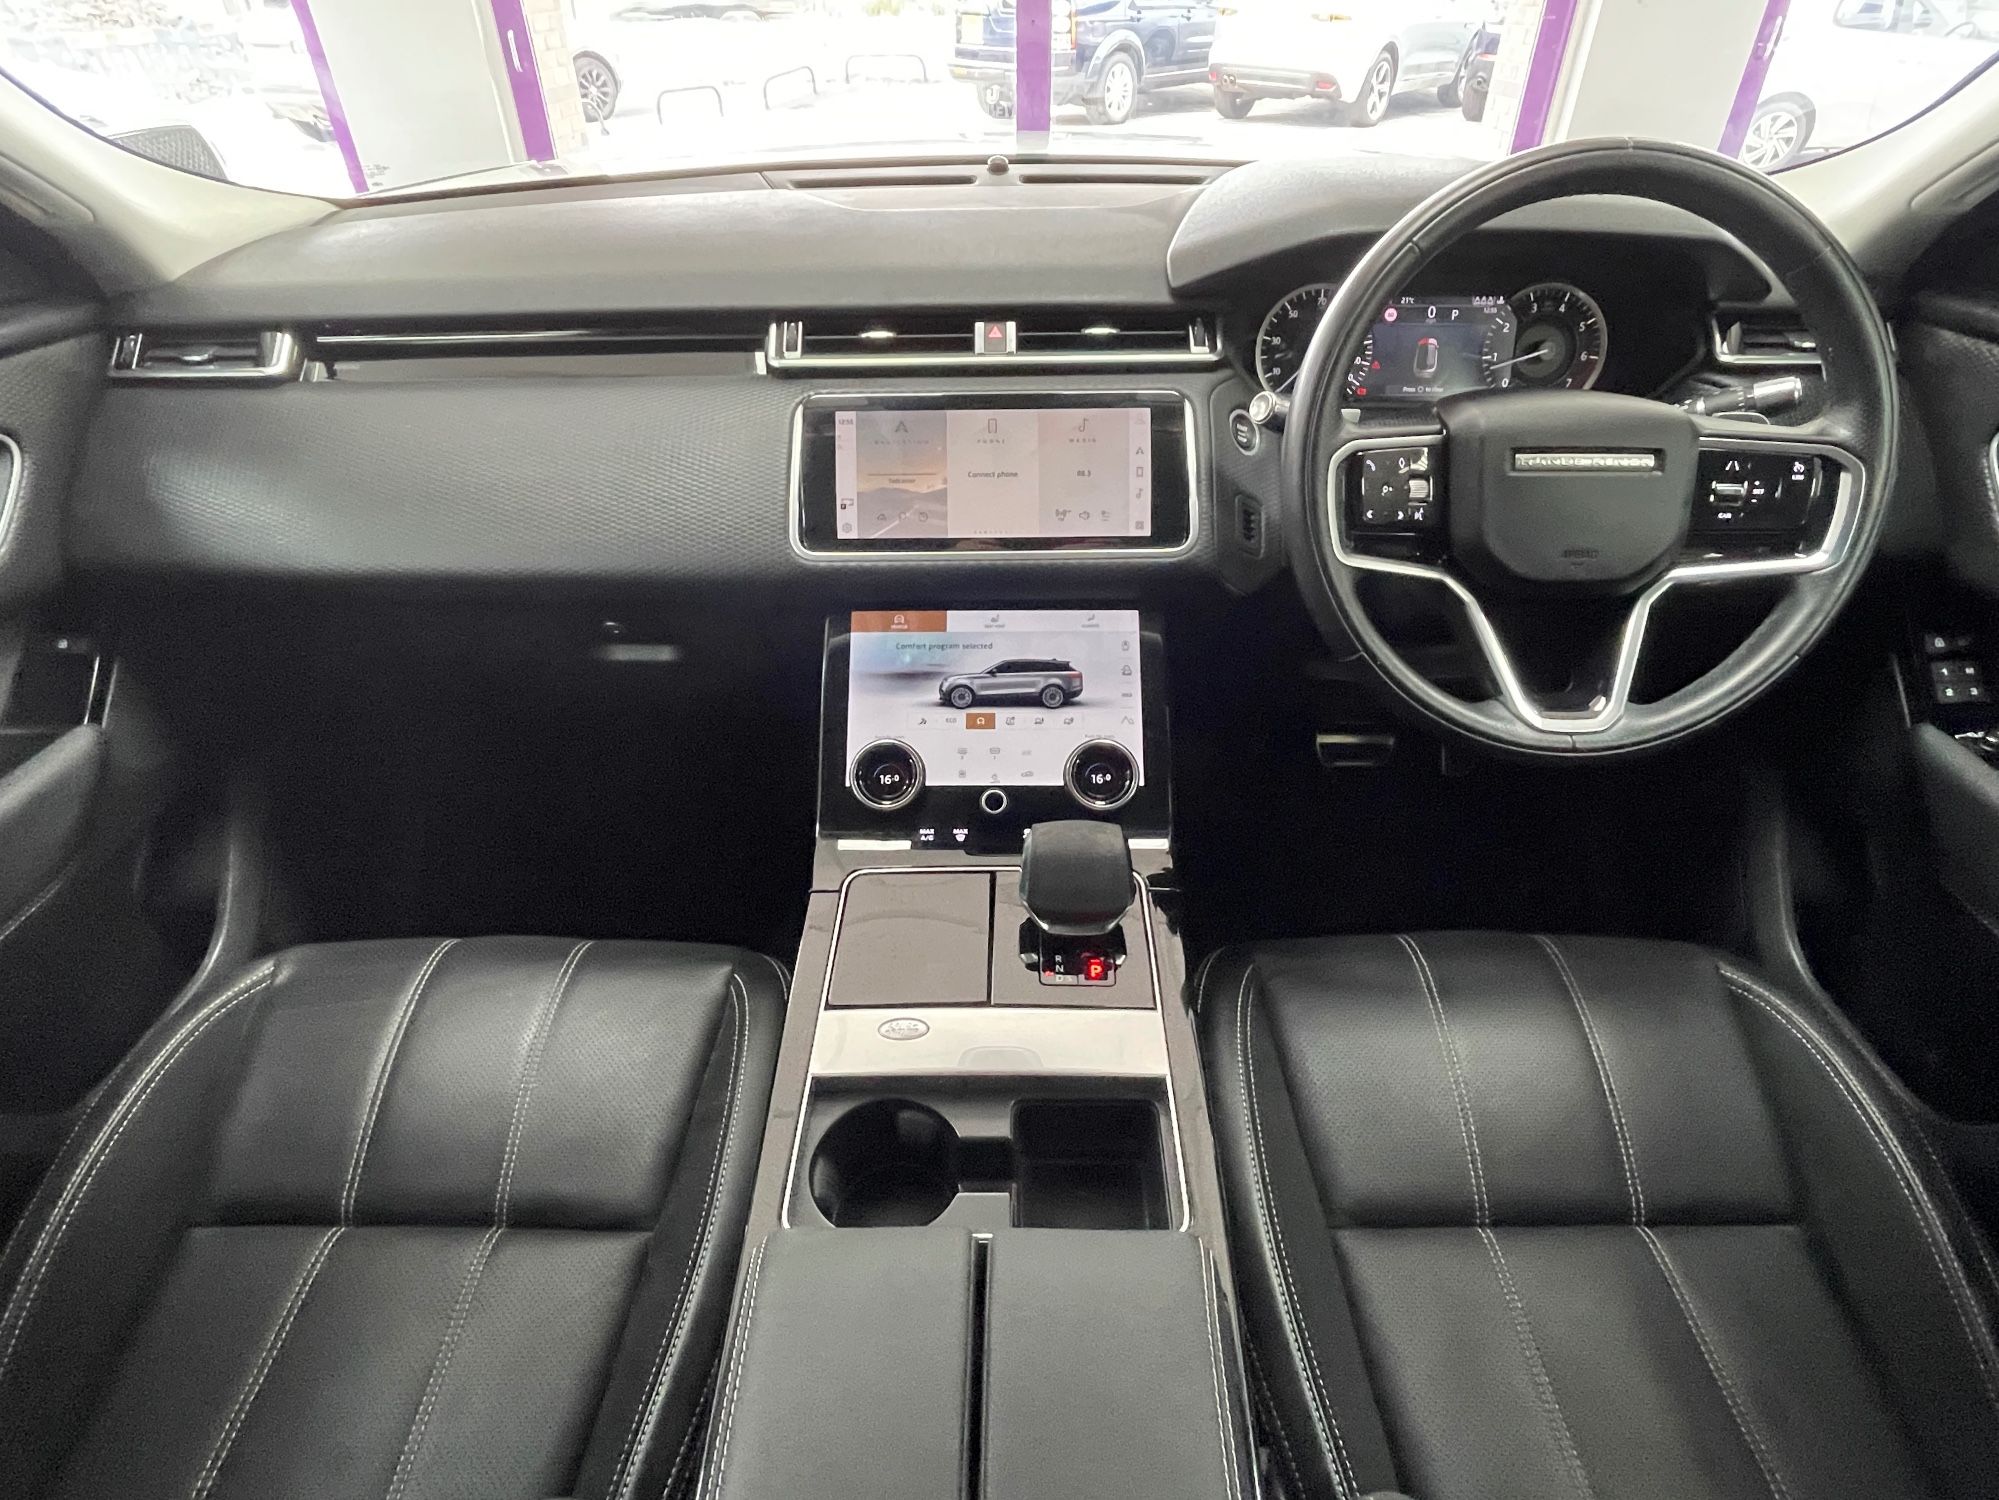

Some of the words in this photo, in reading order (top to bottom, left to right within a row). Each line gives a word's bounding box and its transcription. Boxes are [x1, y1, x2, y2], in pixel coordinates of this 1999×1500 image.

[1427, 305, 1437, 319] 0
[1530, 302, 1537, 313] 3
[1559, 303, 1565, 313] 4
[1288, 310, 1298, 319] 50
[1451, 309, 1459, 320] P
[1502, 322, 1510, 333] 2
[1579, 322, 1586, 332] 5
[1271, 336, 1281, 345] 30
[1492, 353, 1498, 362] 1
[1580, 351, 1588, 361] 6
[1272, 367, 1281, 375] 10
[1501, 378, 1509, 388] 0
[1566, 378, 1573, 388] 7
[928, 643, 960, 651] program
[1055, 955, 1062, 963] R
[1055, 965, 1064, 973] N
[1090, 965, 1102, 978] P
